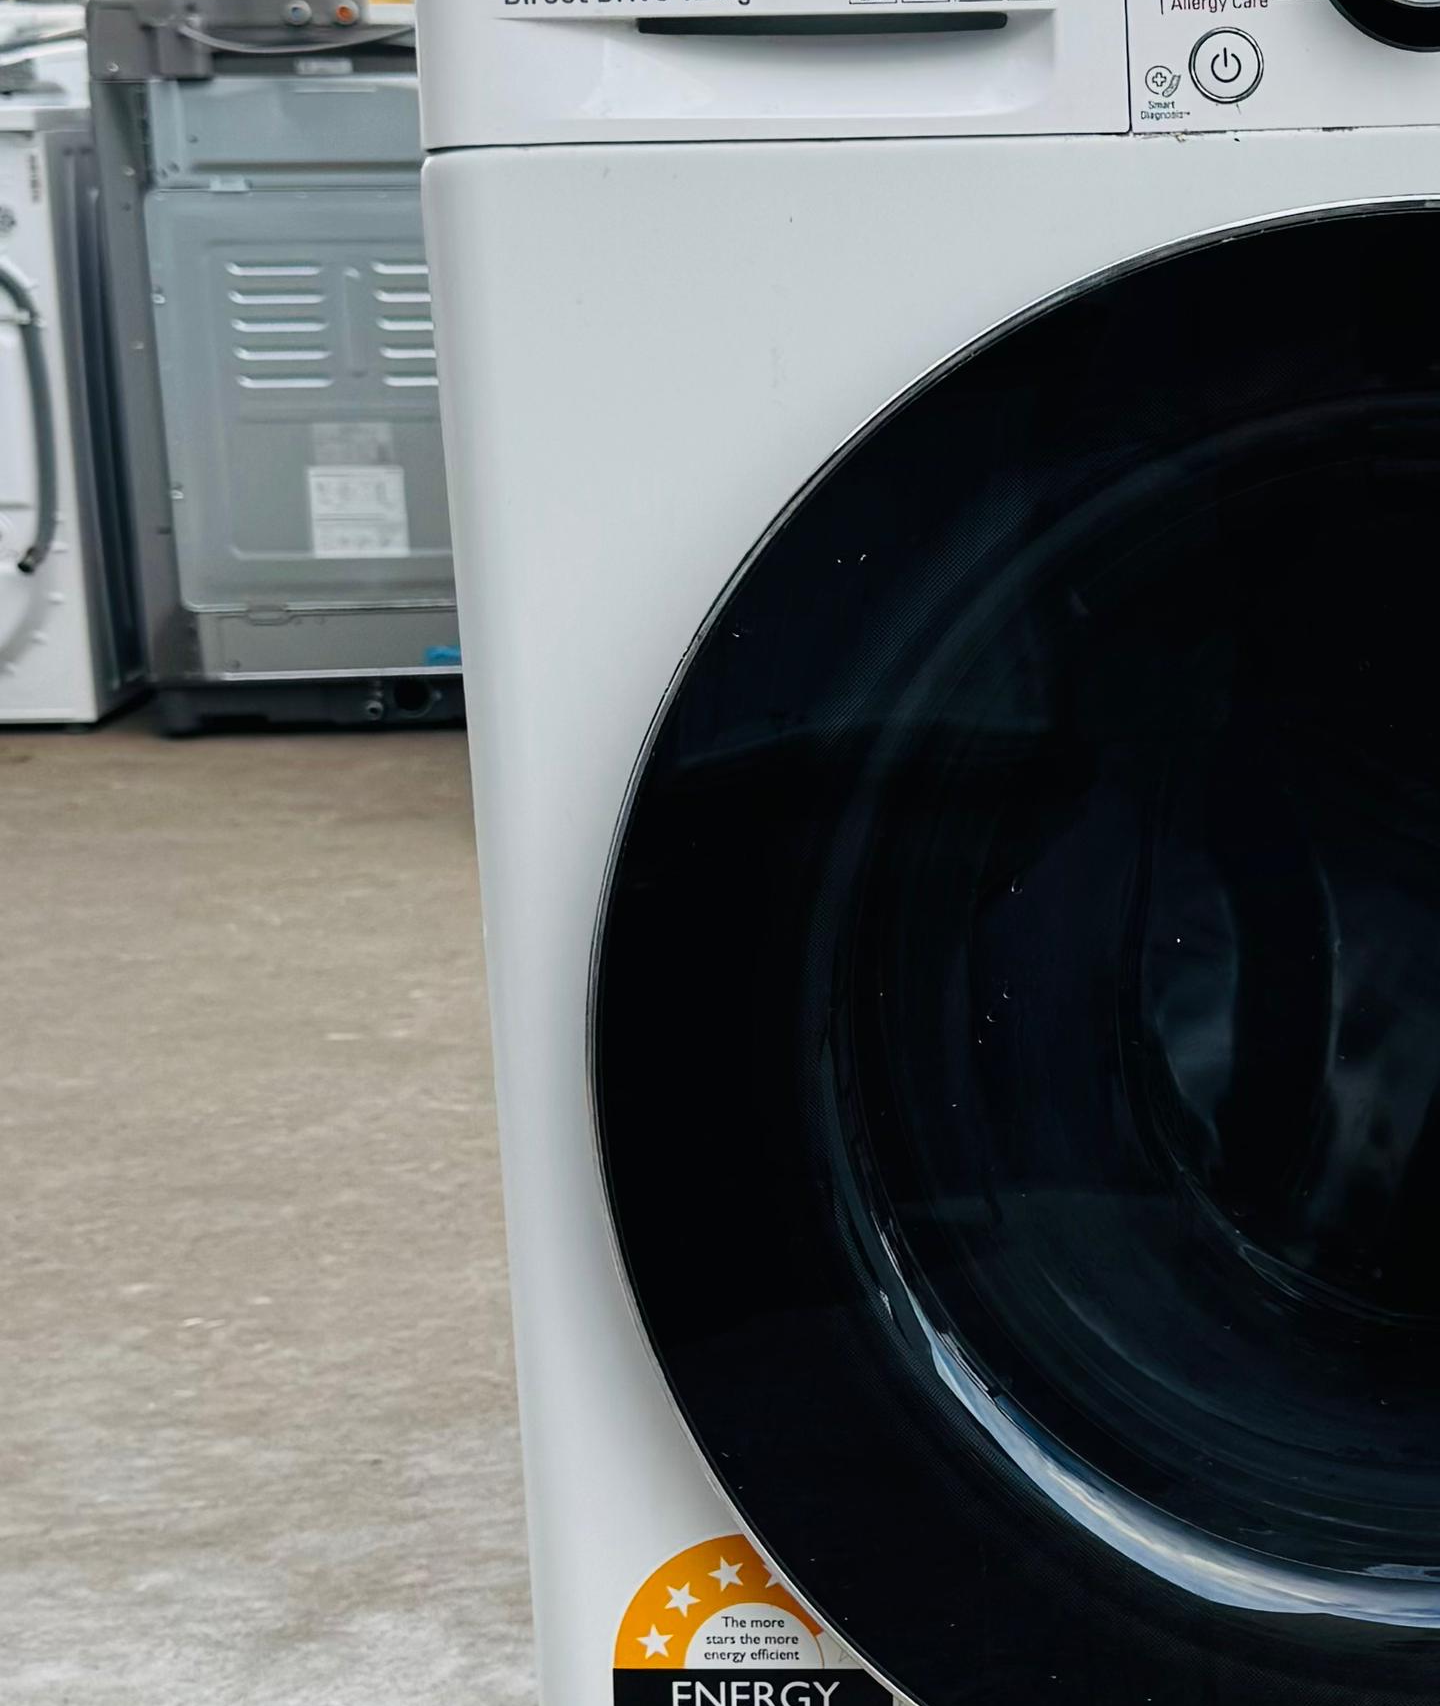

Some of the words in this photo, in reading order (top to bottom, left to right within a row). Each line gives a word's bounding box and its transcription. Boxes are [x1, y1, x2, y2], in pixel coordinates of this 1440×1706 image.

[721, 1616, 747, 1629] The
[750, 1618, 785, 1629] more
[706, 1634, 737, 1645] stars
[740, 1633, 761, 1645] the
[764, 1635, 799, 1645] more
[704, 1650, 746, 1663] energy
[750, 1649, 800, 1661] efficient
